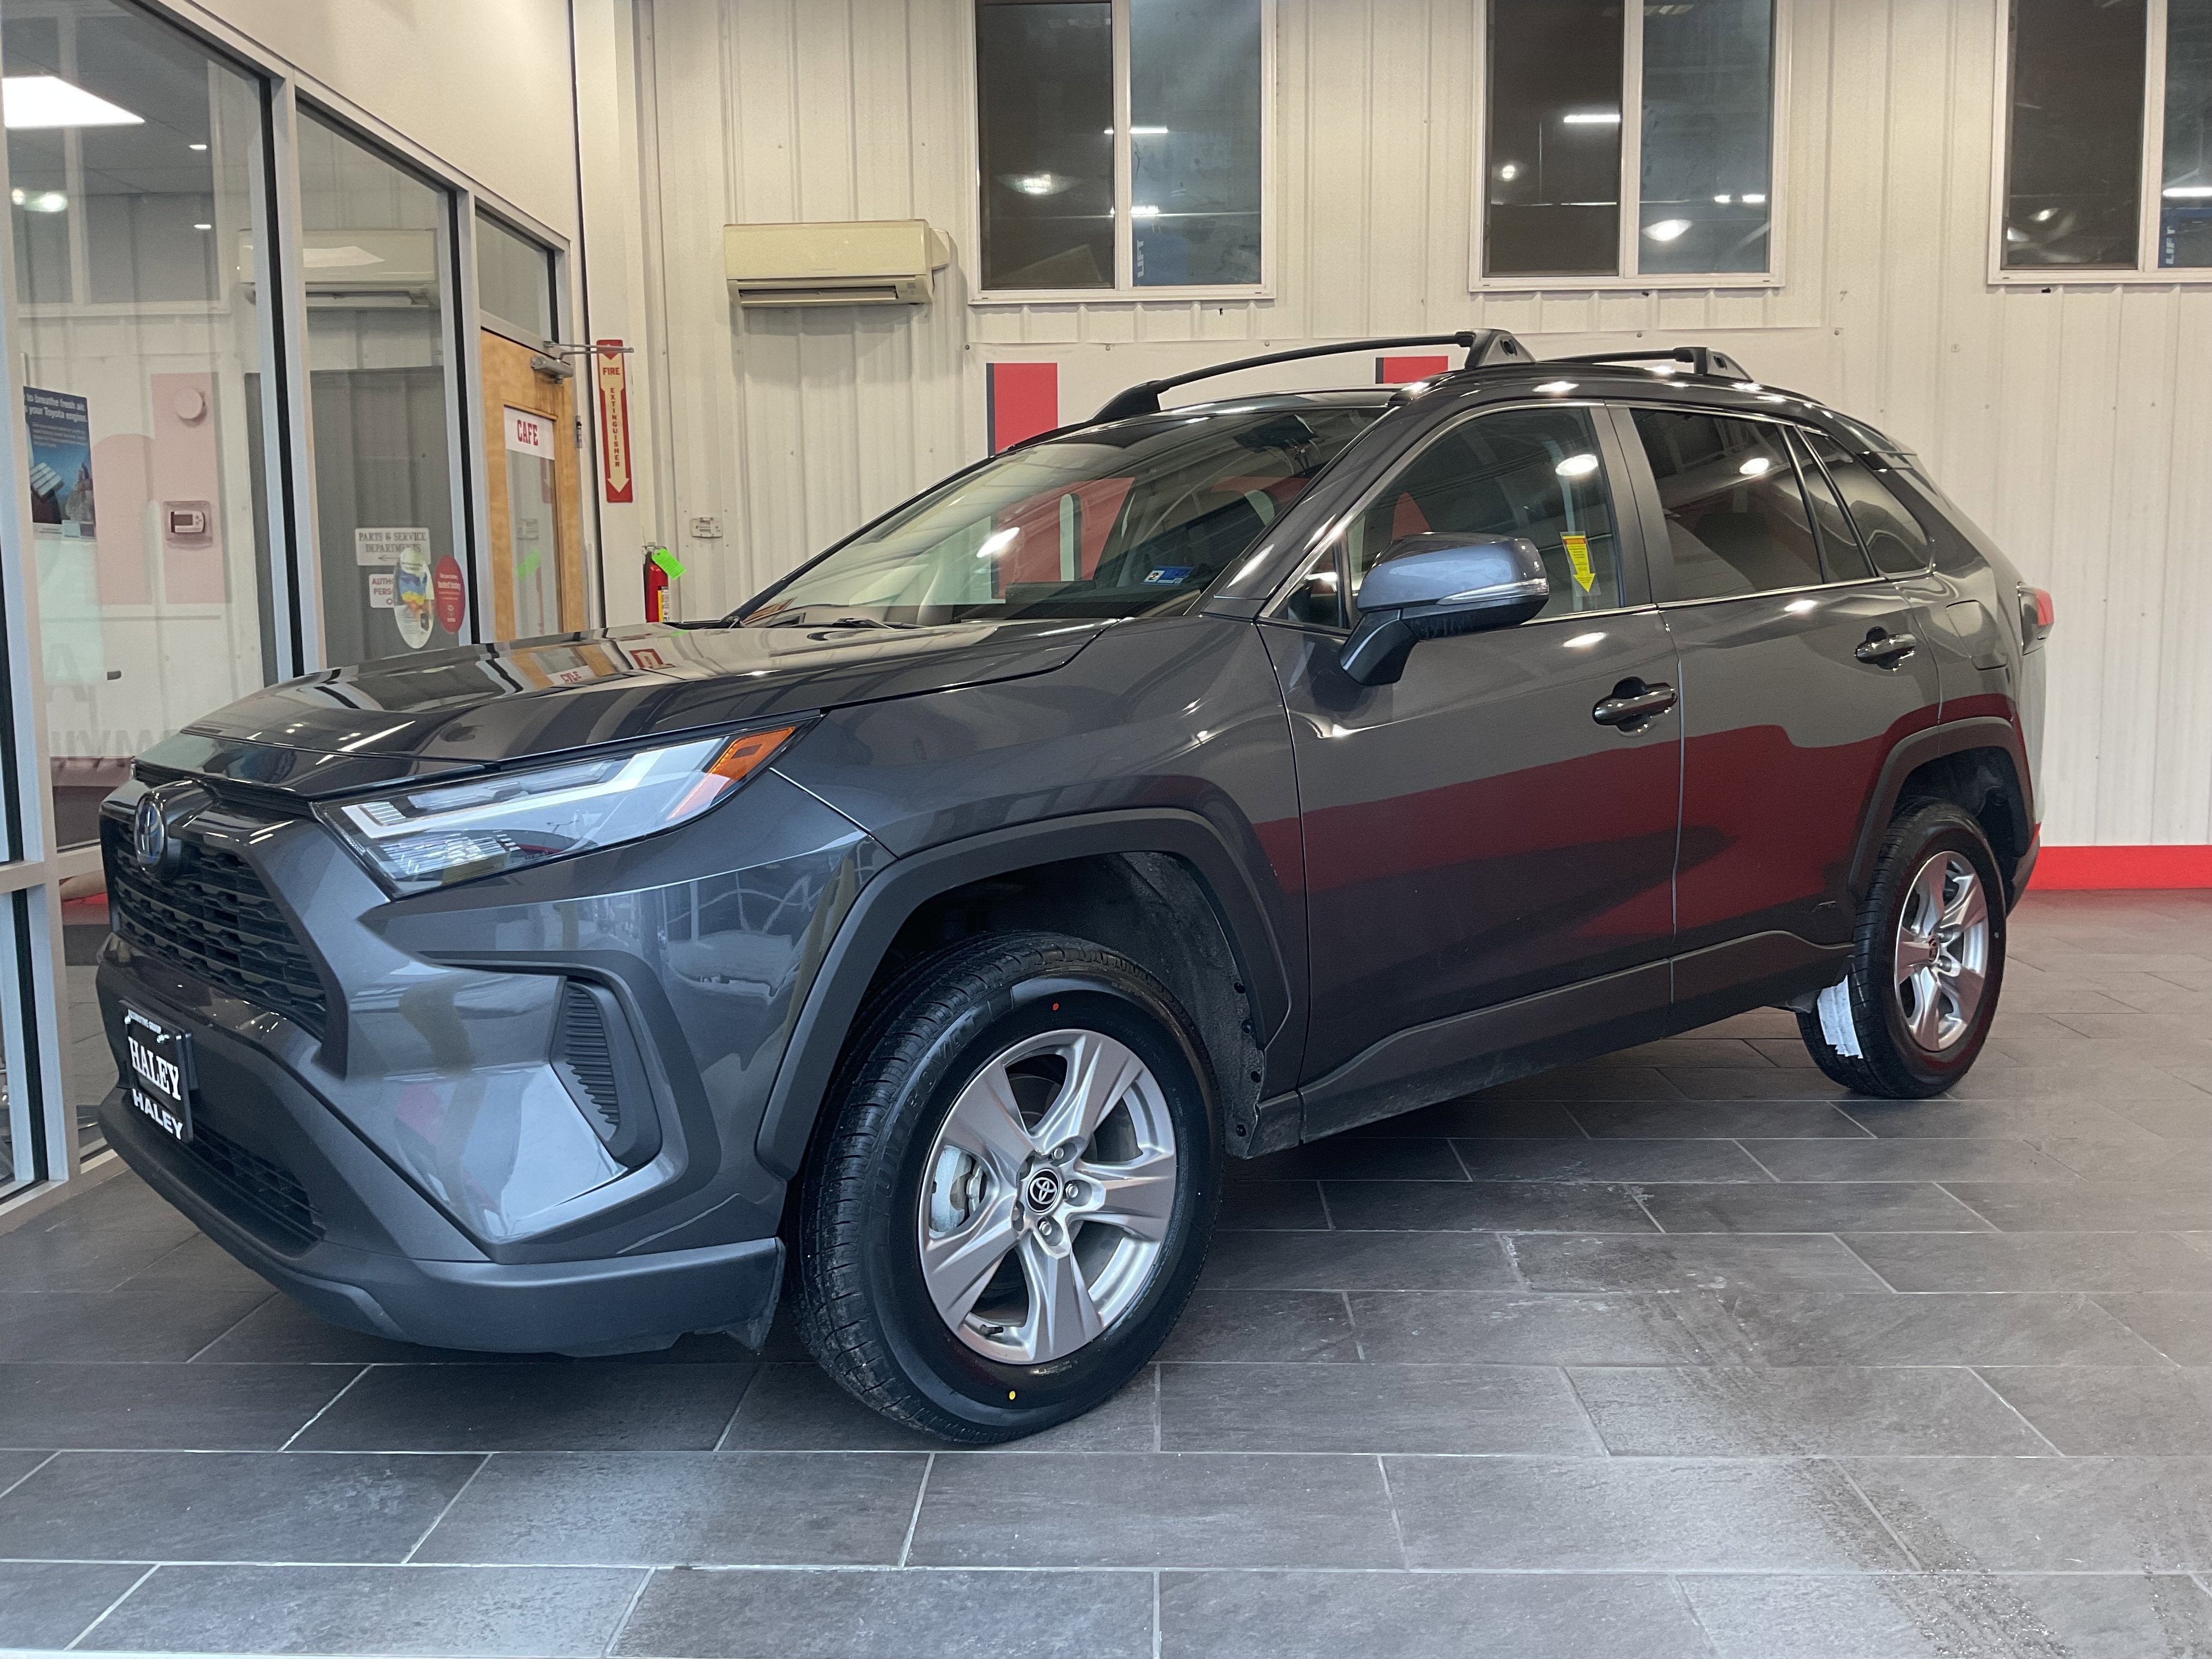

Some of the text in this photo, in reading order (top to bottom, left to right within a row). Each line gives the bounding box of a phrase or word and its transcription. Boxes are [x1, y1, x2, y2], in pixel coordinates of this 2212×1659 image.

[2165, 225, 2175, 264] LIFT
[602, 367, 620, 375] FIRE
[44, 407, 65, 419] Toyota
[610, 387, 620, 467] EXTINGUISHER
[517, 419, 539, 447] CAFE
[358, 532, 426, 541] PARTS & SERVICE
[128, 1036, 182, 1101] HALEY
[132, 1088, 183, 1140] HALEY
